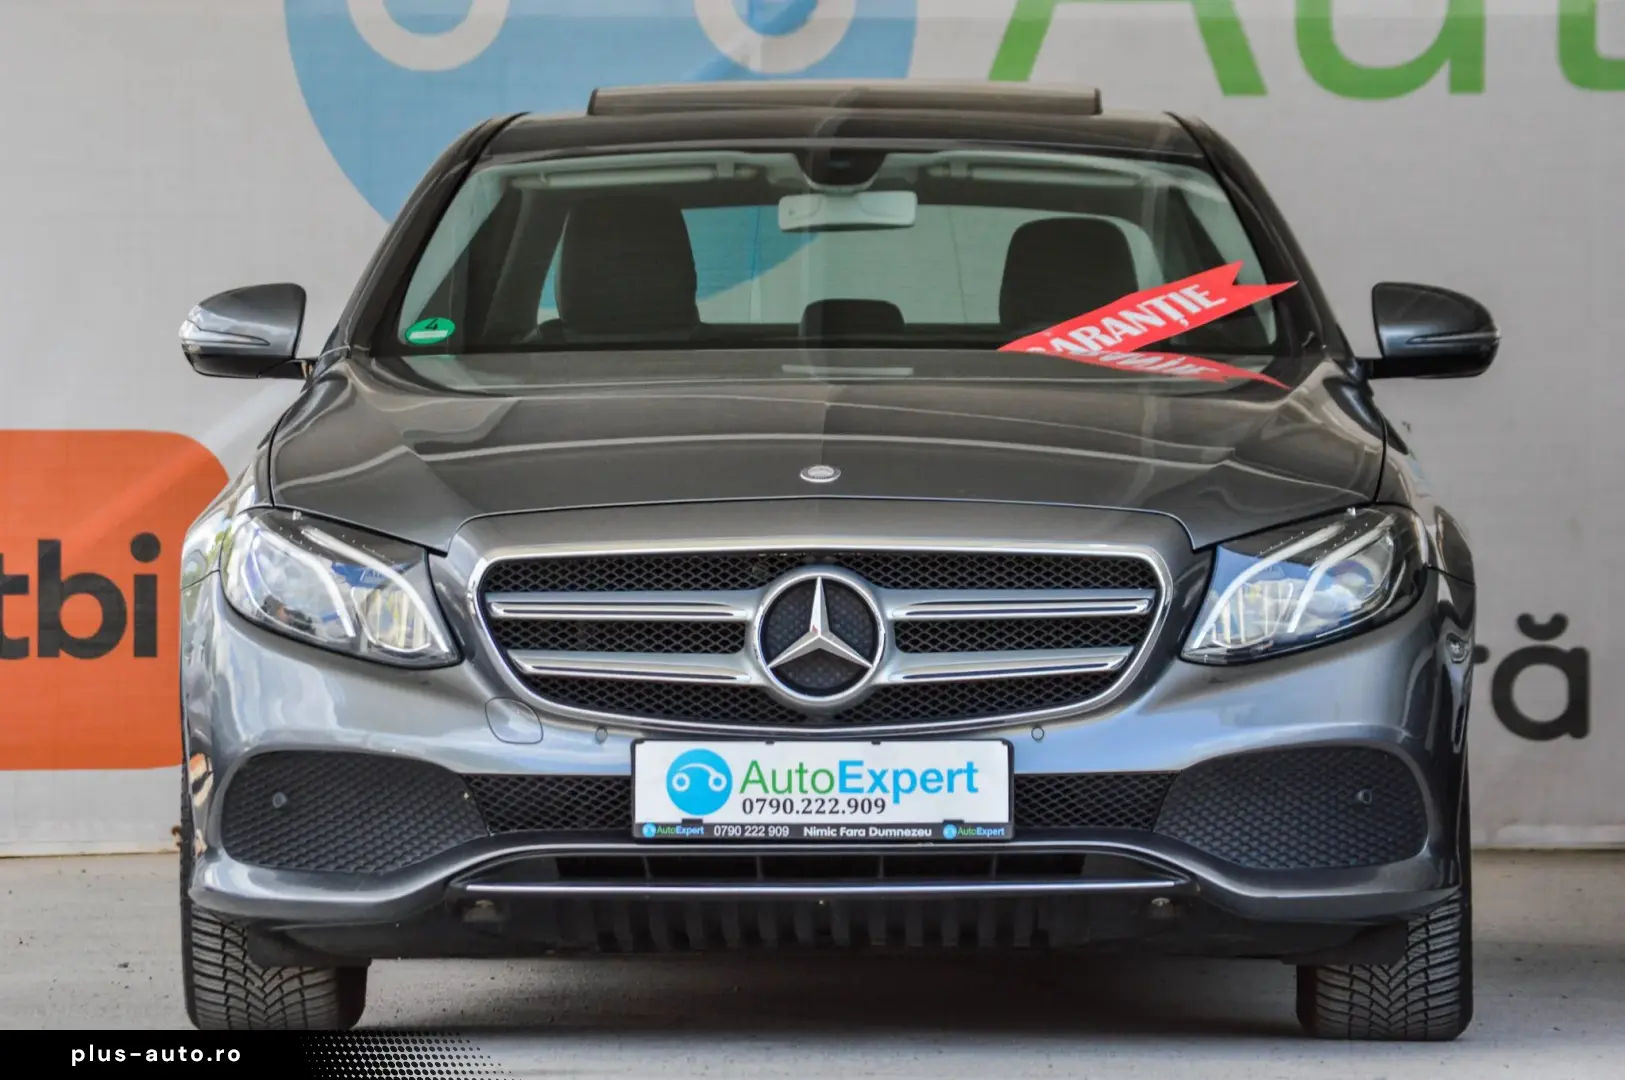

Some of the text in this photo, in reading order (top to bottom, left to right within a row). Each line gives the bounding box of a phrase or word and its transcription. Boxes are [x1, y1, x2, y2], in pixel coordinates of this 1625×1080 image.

[424, 318, 439, 331] 4
[1025, 283, 1228, 353] ARANȚIE
[1473, 612, 1590, 742] ă
[739, 759, 979, 805] AutoExpert
[742, 797, 886, 815] 0790.222.909
[656, 825, 704, 836] AutoExpert
[713, 825, 790, 837] 0790 222 909
[803, 826, 932, 838] Nimic Fara Dumnezeu
[957, 826, 1005, 837] AutoExpert
